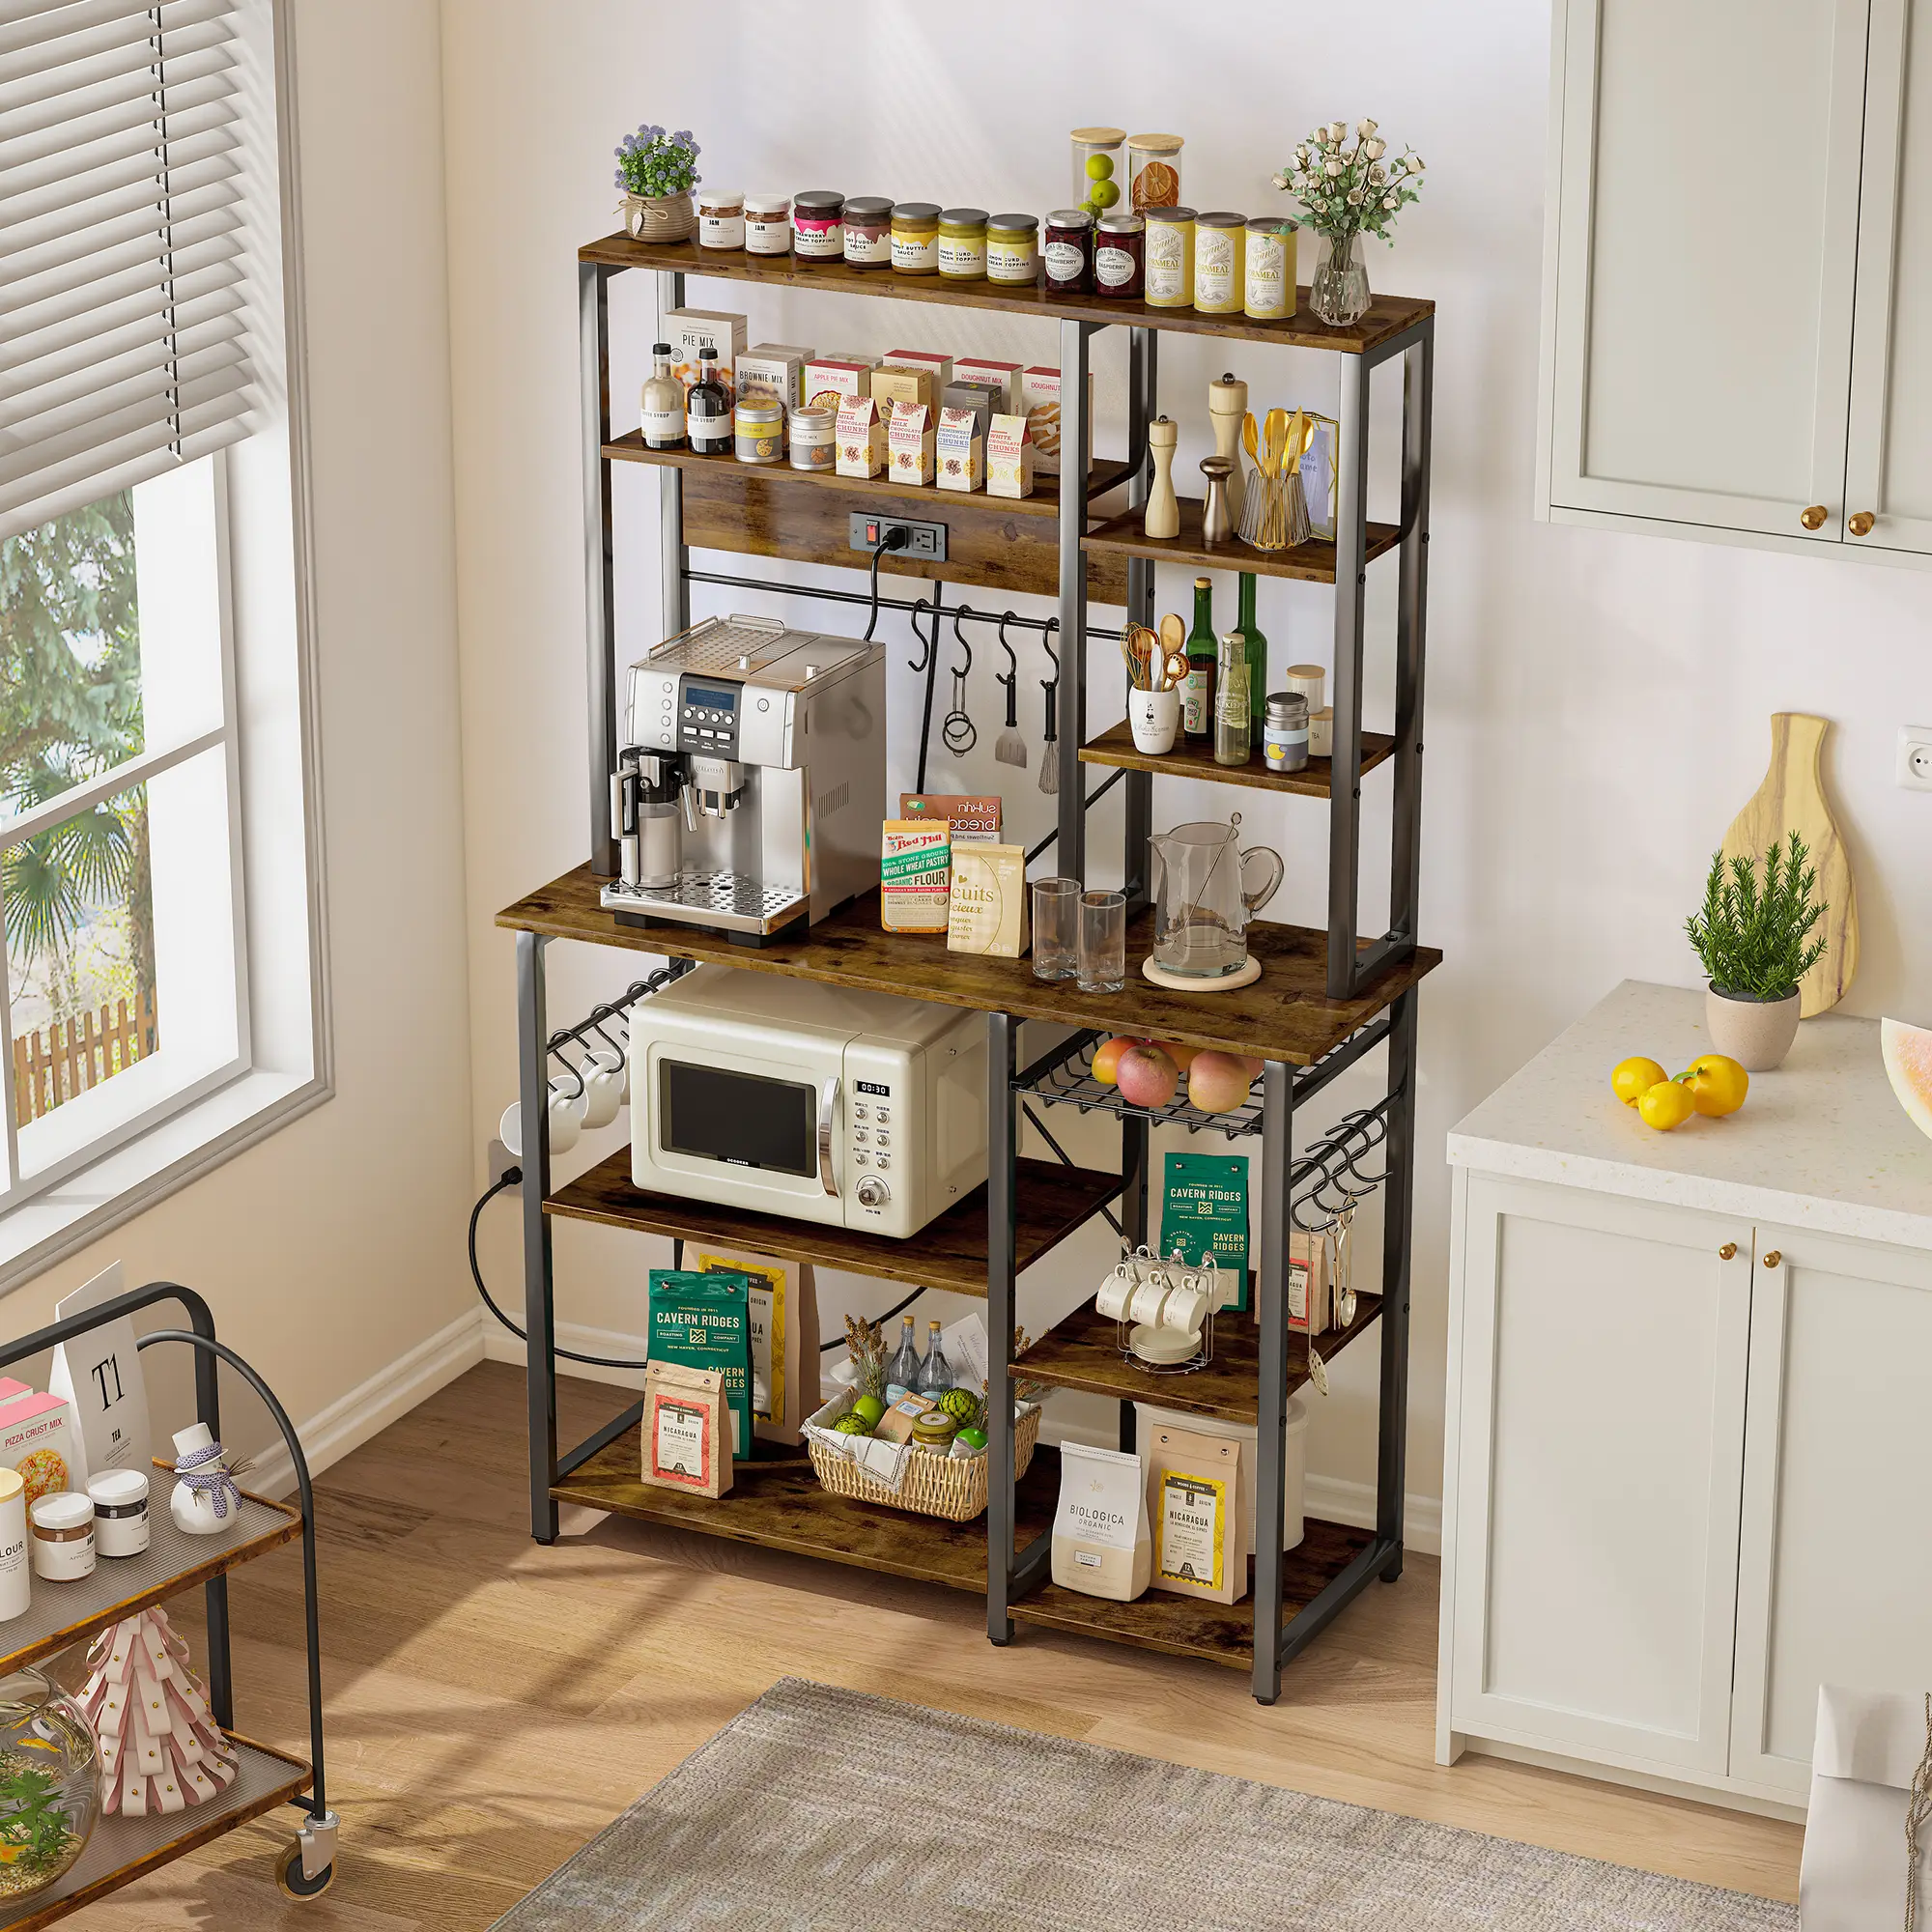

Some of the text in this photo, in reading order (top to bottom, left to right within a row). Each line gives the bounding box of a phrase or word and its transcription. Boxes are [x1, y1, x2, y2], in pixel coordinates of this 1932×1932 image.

[682, 334, 715, 349] PIE MIX
[739, 370, 783, 384] BROWNIE MIX
[813, 373, 829, 382] APPLE
[961, 373, 991, 384] DOUGHNUT
[837, 419, 867, 428] CHOCOLATE
[837, 425, 867, 435] CHUNKS
[890, 426, 921, 435] CHOCOLATE
[890, 432, 921, 441] CHUNKS
[938, 432, 969, 440] CHOCOLATE
[939, 427, 970, 436] SEMISWEET
[938, 437, 969, 446] CHUNKS
[988, 439, 1020, 447] CHOCOLATE
[988, 444, 1020, 453] CHUNKS
[896, 837, 920, 852] Red
[920, 834, 943, 847] Mill
[897, 855, 920, 866] STONE
[921, 848, 949, 861] GROUND
[883, 854, 950, 877] WHOLE WHEAT PASTRY
[887, 871, 946, 886] ORGANIC FLOUR
[952, 885, 994, 903] cuits
[861, 1083, 886, 1094] 00:30
[1170, 1188, 1241, 1202] CAVERN RIDGES
[1213, 1233, 1244, 1242] CAVERN
[1213, 1242, 1244, 1251] RIDGES
[750, 1297, 767, 1306] ORIGIN
[657, 1312, 740, 1328] CAVERN RIDGES
[91, 1352, 126, 1412] T1
[5, 1433, 25, 1448] PIZZA
[25, 1423, 48, 1439] CRUST
[49, 1417, 63, 1430] MIX
[111, 1428, 122, 1443] TEA
[663, 1426, 697, 1439] NICARAGUA
[1069, 1504, 1124, 1525] BIOLOGICA
[1169, 1510, 1208, 1527] NICARAGUA
[1078, 1518, 1112, 1531] ORGANIC
[0, 1541, 23, 1558] LOUR
[1183, 1563, 1191, 1572] 12
